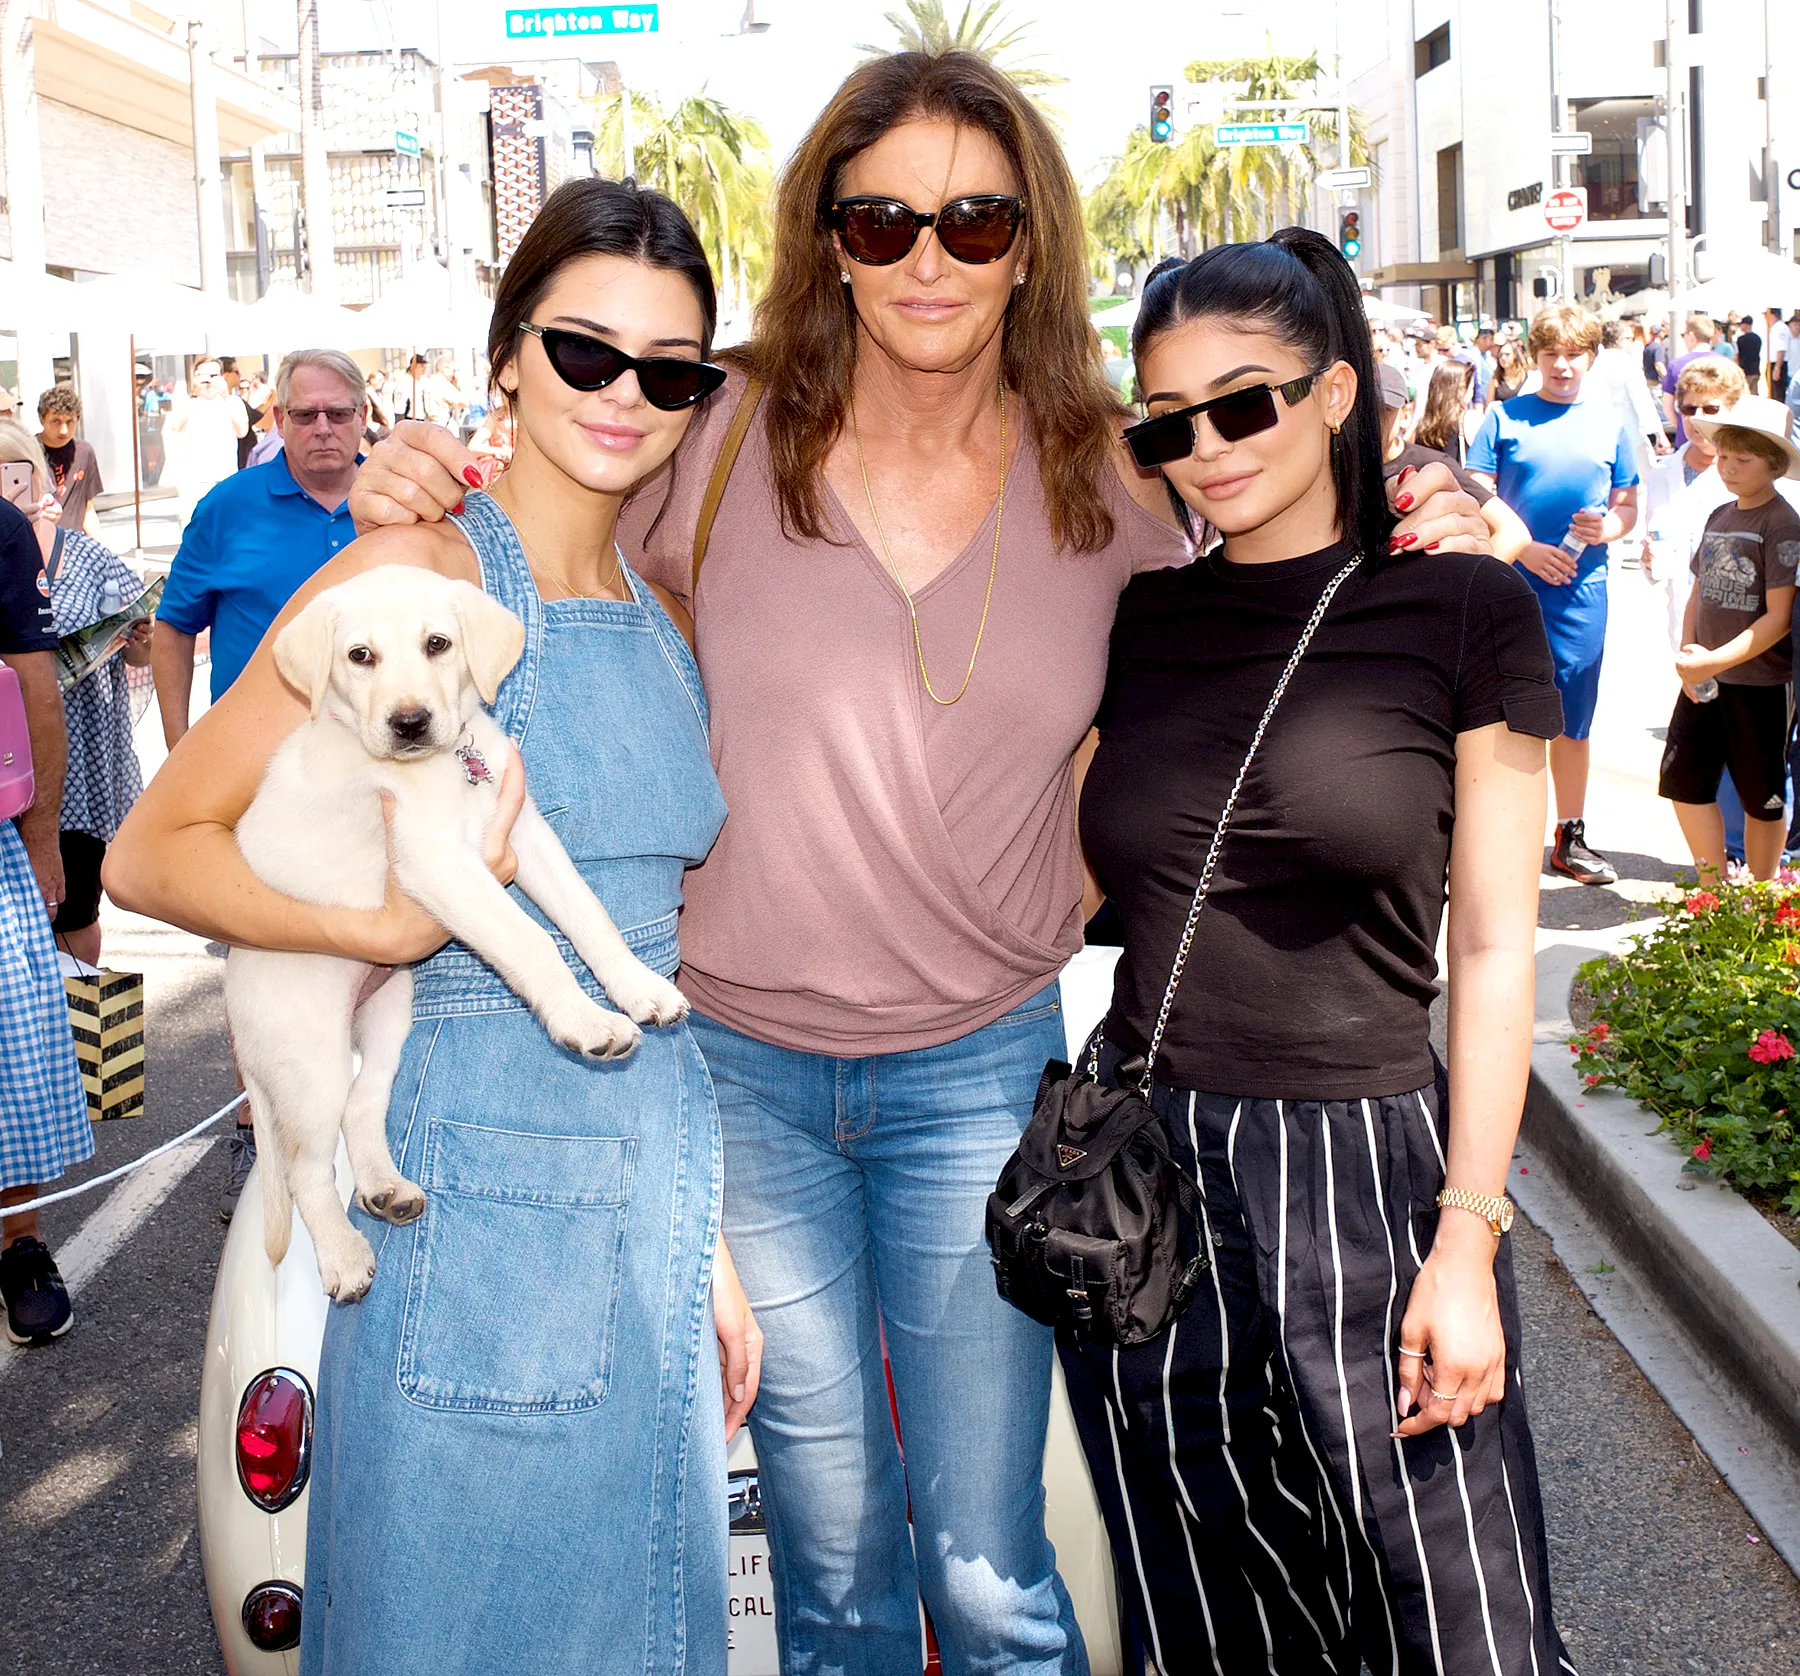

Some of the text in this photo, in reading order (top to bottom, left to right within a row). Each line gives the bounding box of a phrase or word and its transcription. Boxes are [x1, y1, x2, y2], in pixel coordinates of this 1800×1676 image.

[509, 9, 654, 36] Brighton Way
[1218, 126, 1304, 142] Brighton Way
[1702, 587, 1760, 606] PRIME
